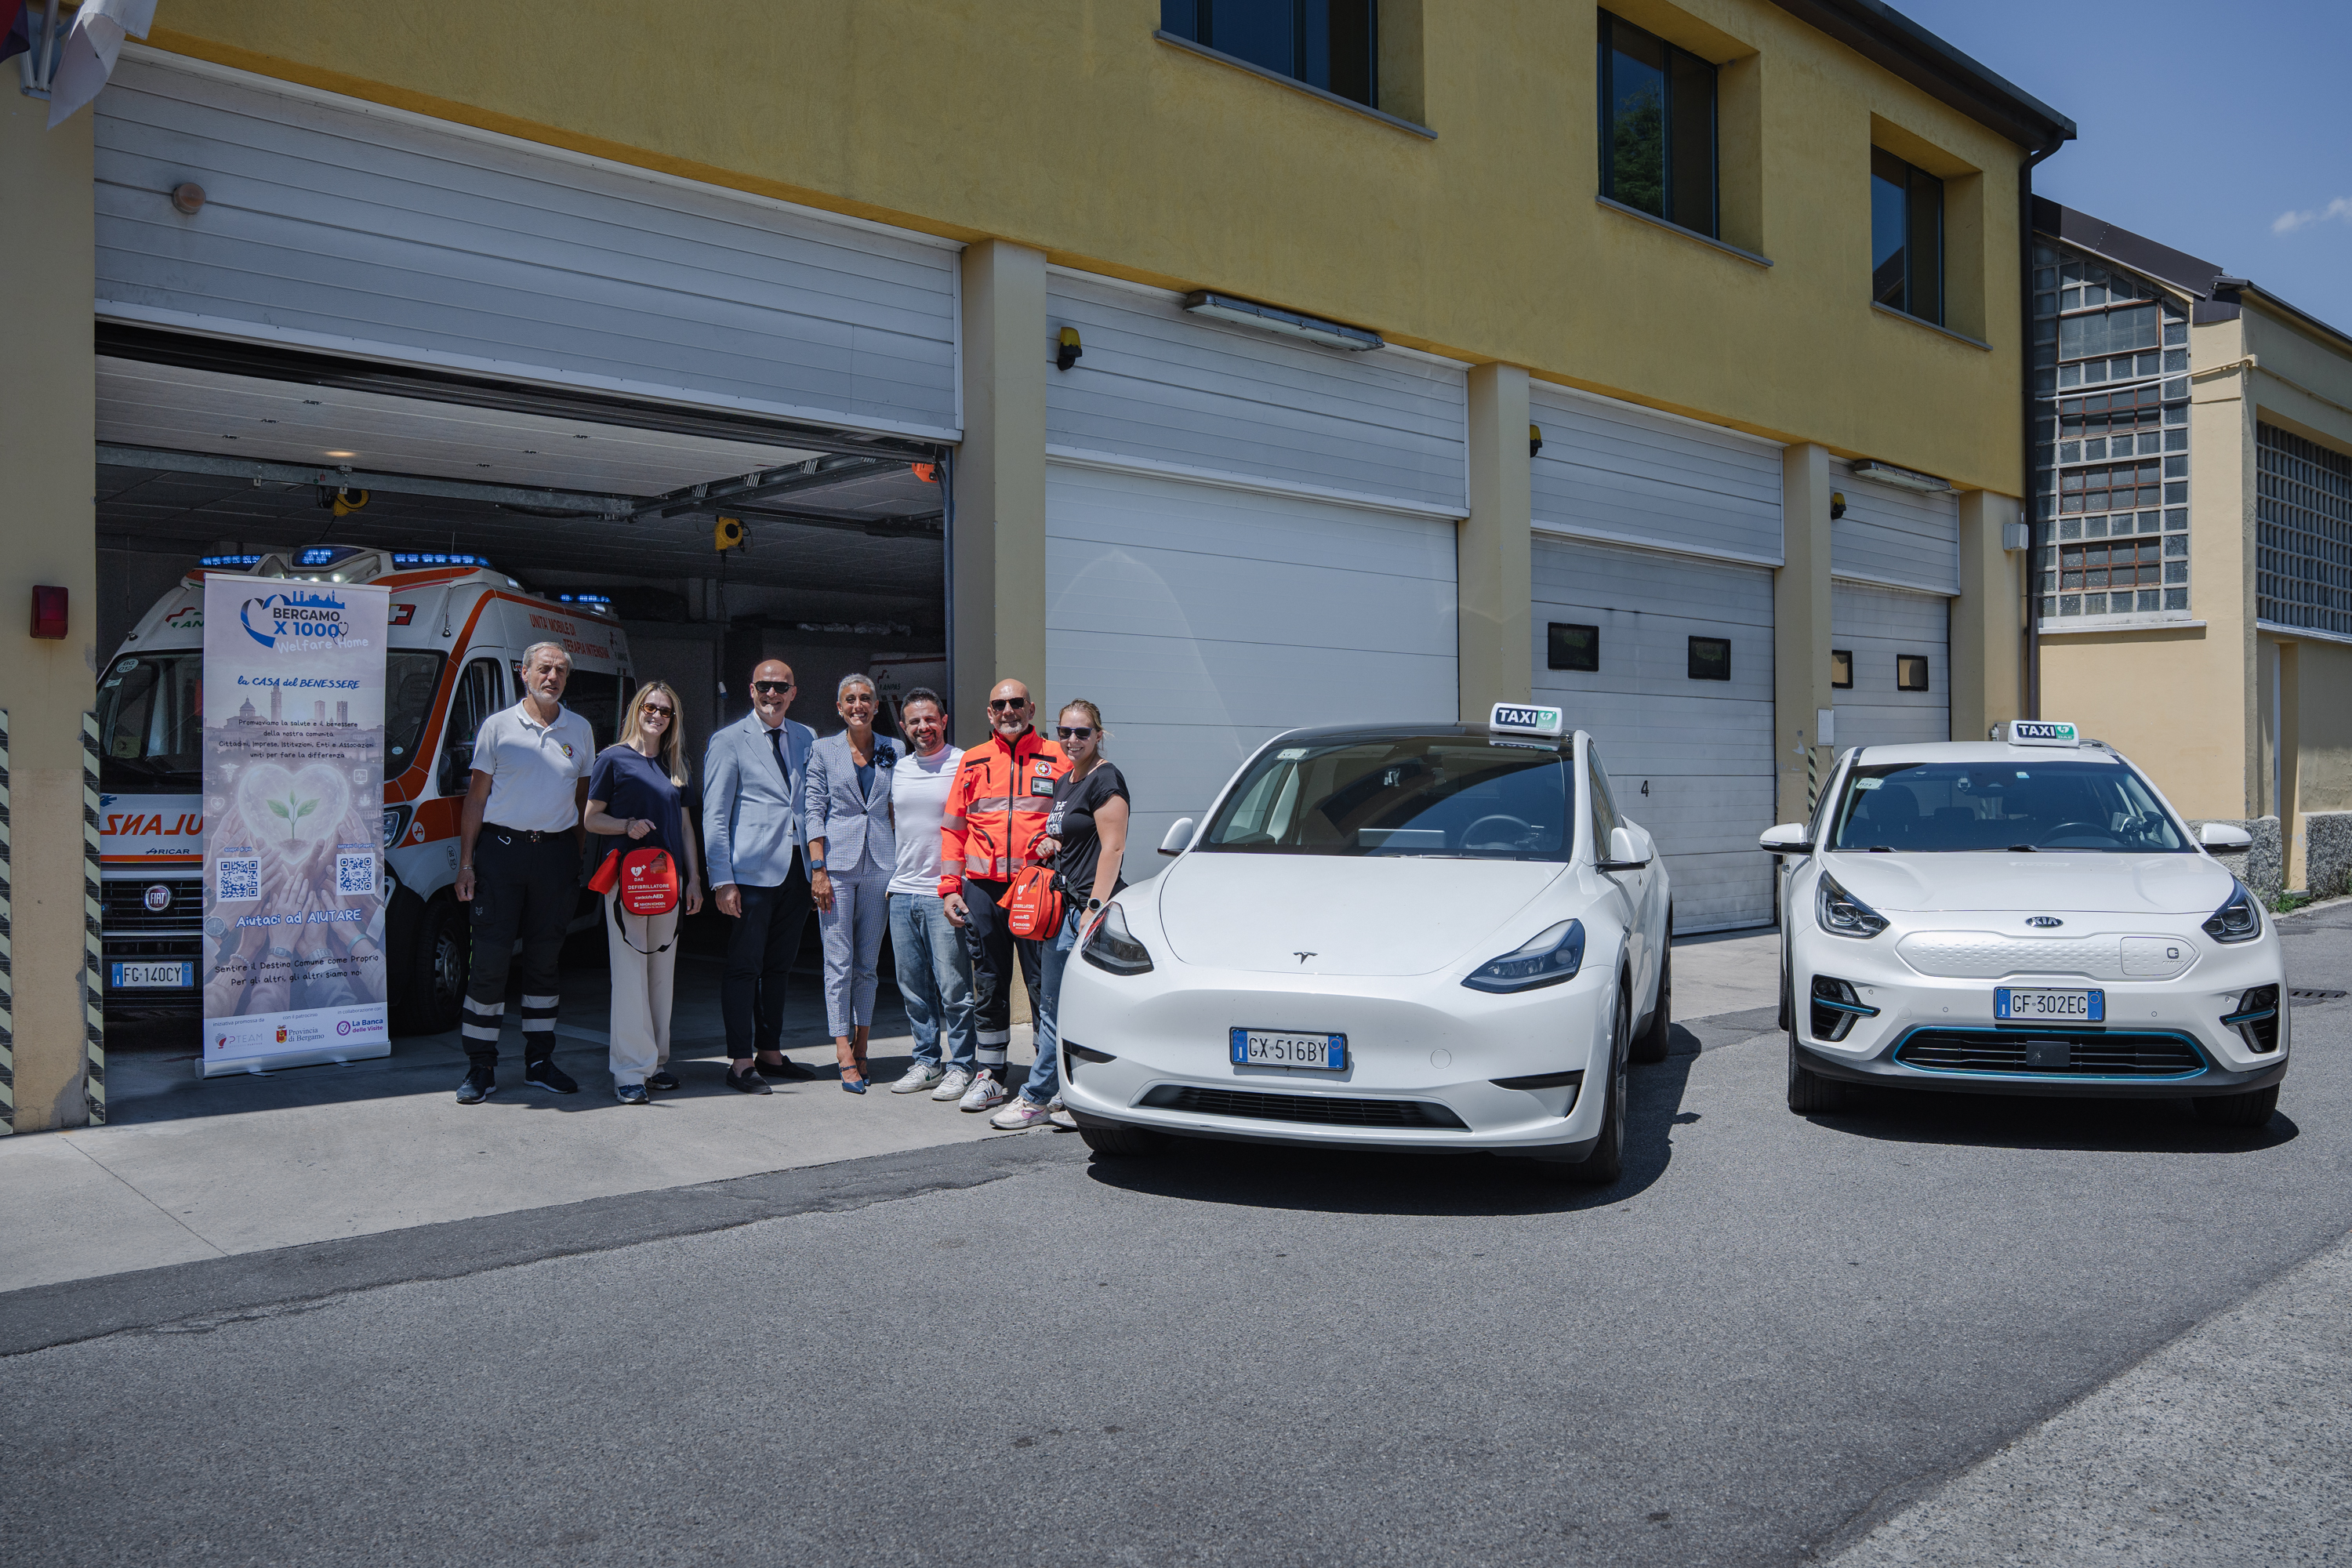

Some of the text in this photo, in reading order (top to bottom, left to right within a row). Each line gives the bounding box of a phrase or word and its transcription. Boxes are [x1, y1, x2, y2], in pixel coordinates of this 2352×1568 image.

[273, 608, 340, 622] BERGAMO
[274, 621, 339, 637] X 1000
[548, 619, 570, 635] MOBILE
[569, 624, 576, 636] DI
[277, 637, 369, 654] Welfare Home
[563, 639, 586, 655] TERAPIA
[587, 644, 610, 659] INTENSIVA
[237, 676, 360, 690] la CASA del BENESSERE
[1499, 709, 1537, 724] TAXI
[2018, 725, 2055, 736] TAXI
[1641, 780, 1649, 797] 4
[1054, 801, 1067, 811] THE
[1047, 811, 1065, 823] ORTH
[150, 893, 166, 904] FIAT
[236, 909, 362, 927] Aiutaci ad AIUTARE
[351, 955, 379, 963] Proprio
[250, 976, 260, 986] gli
[290, 973, 299, 983] gli
[289, 1027, 318, 1035] Provincia
